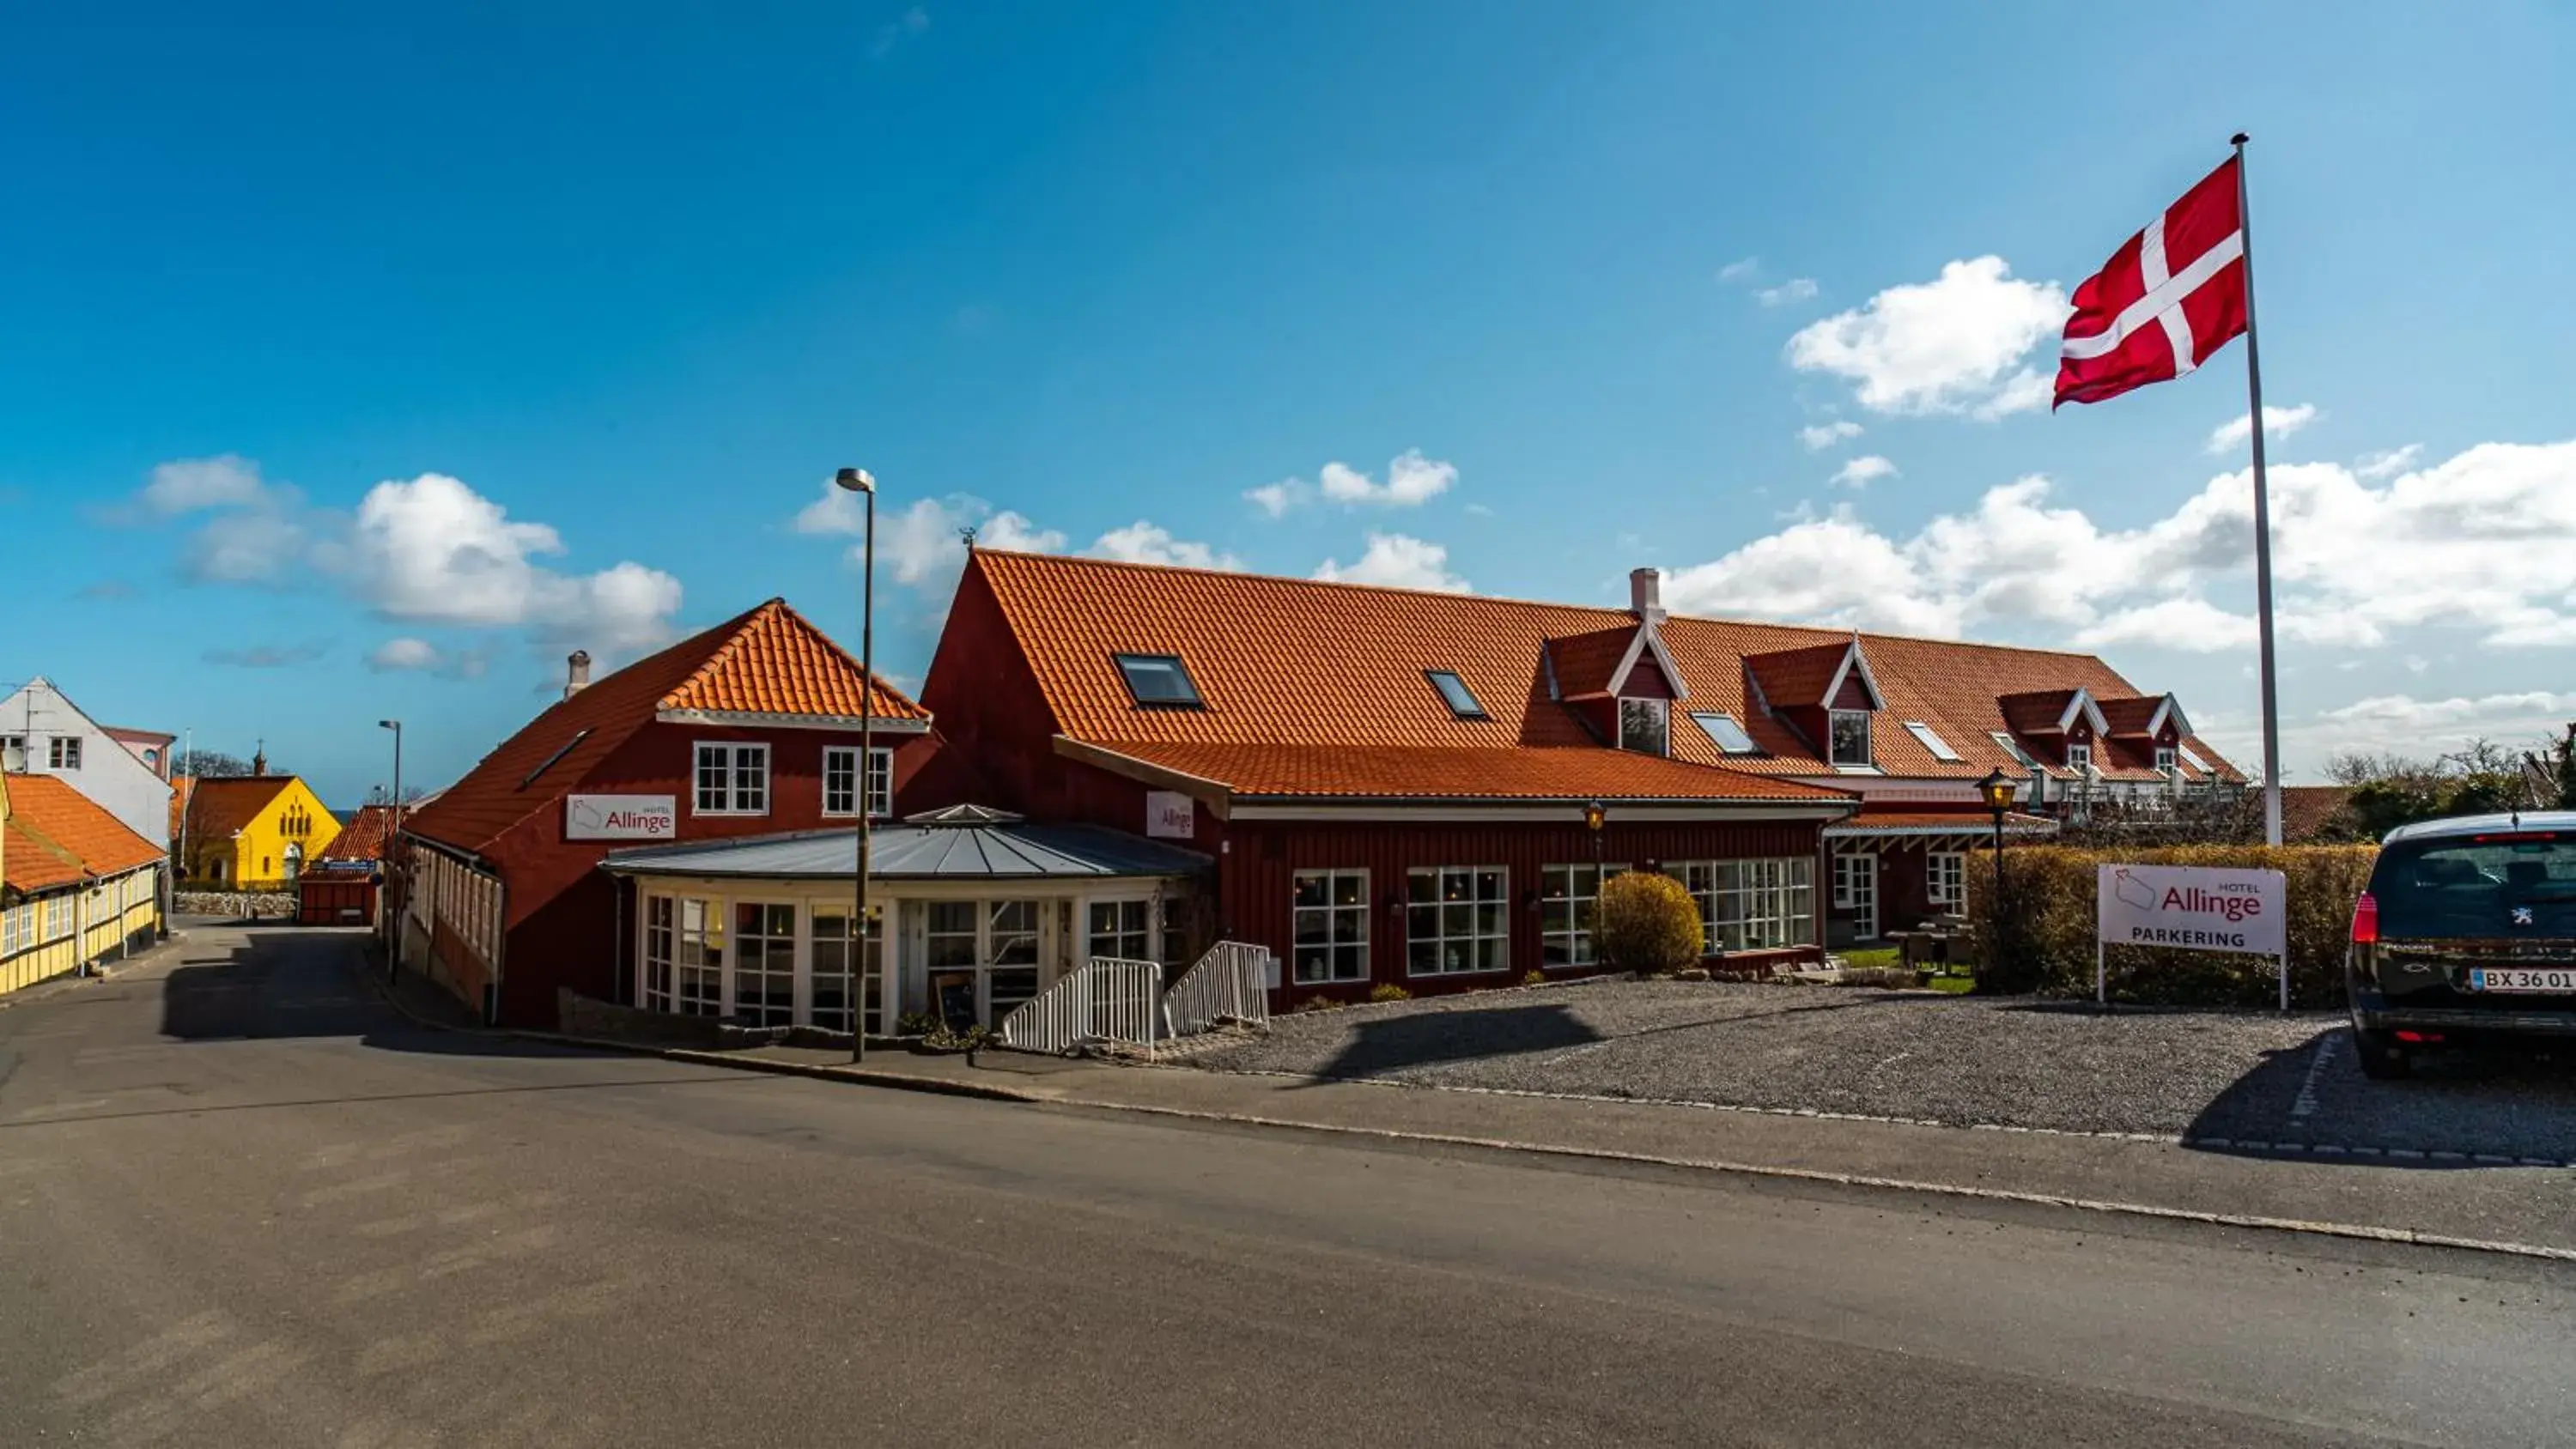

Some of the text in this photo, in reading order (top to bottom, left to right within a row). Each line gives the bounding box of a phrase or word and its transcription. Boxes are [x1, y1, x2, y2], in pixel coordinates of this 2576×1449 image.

[605, 811, 671, 834] Allinge
[2219, 882, 2261, 894] HOTEL
[2161, 886, 2261, 922] Allinge
[2132, 926, 2245, 948] PARKERING
[2486, 973, 2513, 986] BX
[2518, 973, 2543, 987] 36
